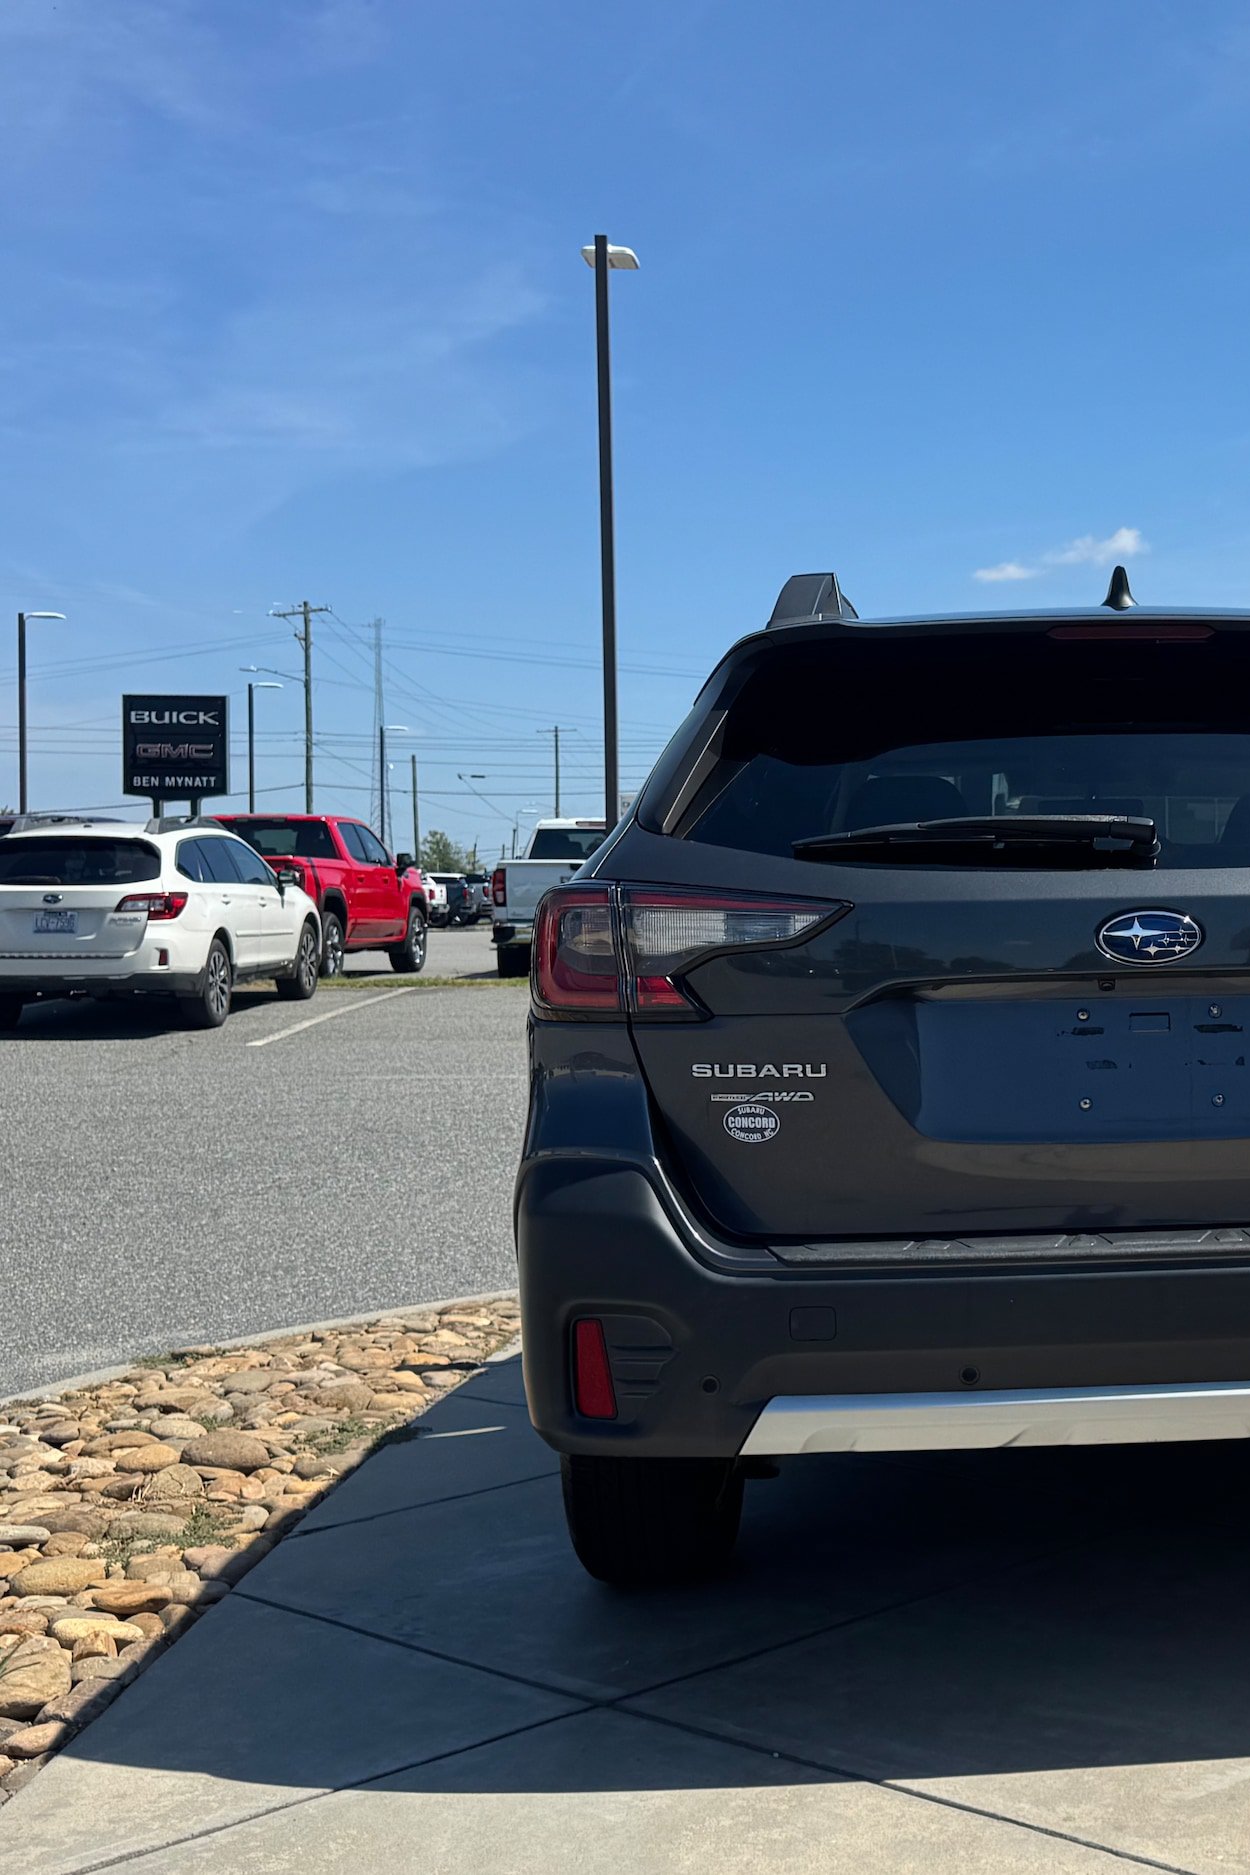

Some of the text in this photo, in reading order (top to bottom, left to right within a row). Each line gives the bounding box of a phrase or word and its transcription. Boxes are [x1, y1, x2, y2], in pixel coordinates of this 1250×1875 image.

[130, 710, 219, 725] BUICK
[136, 743, 214, 759] GMC
[132, 776, 216, 788] BEN MYNATT
[691, 1063, 827, 1078] SUBARU
[749, 1091, 815, 1102] AWD
[737, 1106, 765, 1115] SUBARU
[728, 1116, 776, 1129] CONCORD
[763, 1128, 774, 1138] NC
